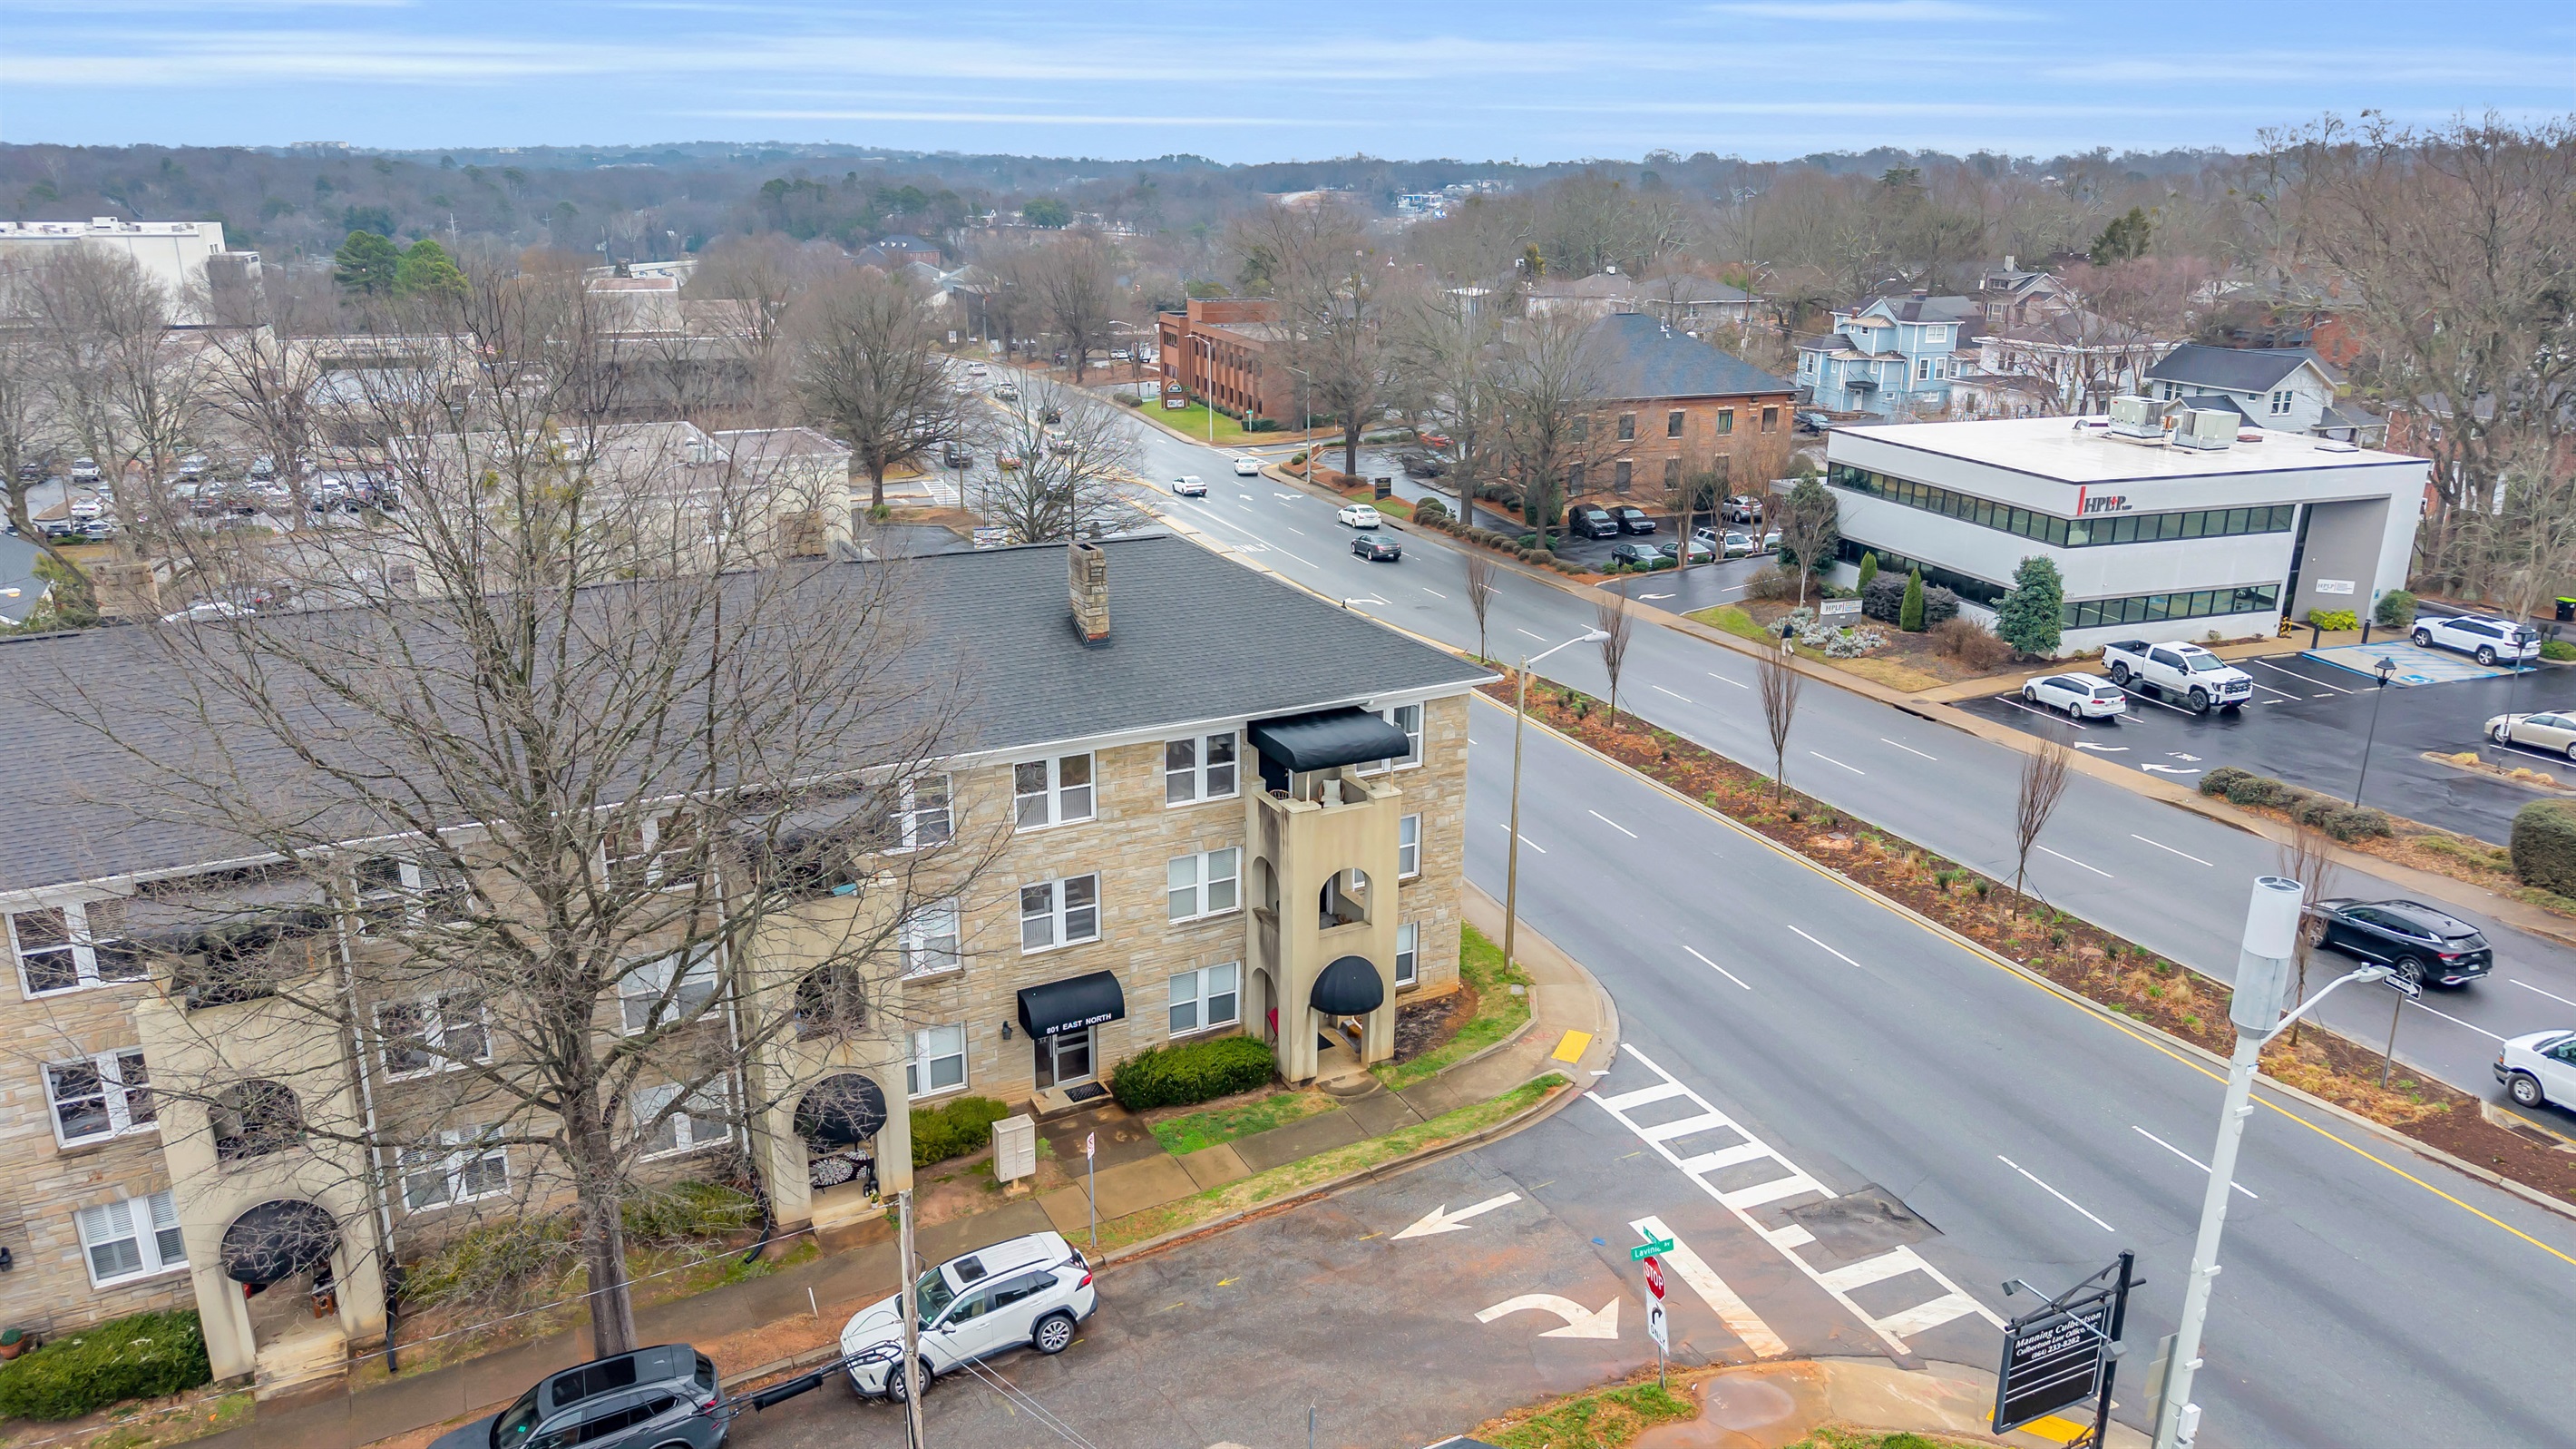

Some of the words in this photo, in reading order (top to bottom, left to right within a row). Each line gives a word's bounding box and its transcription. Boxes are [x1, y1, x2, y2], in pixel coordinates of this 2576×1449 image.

[1046, 1025, 1059, 1034] 801
[1062, 1020, 1083, 1031] EAST
[1085, 1013, 1112, 1025] NORTH
[1644, 1261, 1664, 1290] STOP
[1650, 1325, 1665, 1346] ONLY
[2015, 1328, 2054, 1349] Manning
[2016, 1339, 2051, 1356] Culbertson
[2052, 1335, 2064, 1344] Law
[2031, 1348, 2047, 1360] (864)
[2047, 1336, 2081, 1353] 233-8282
